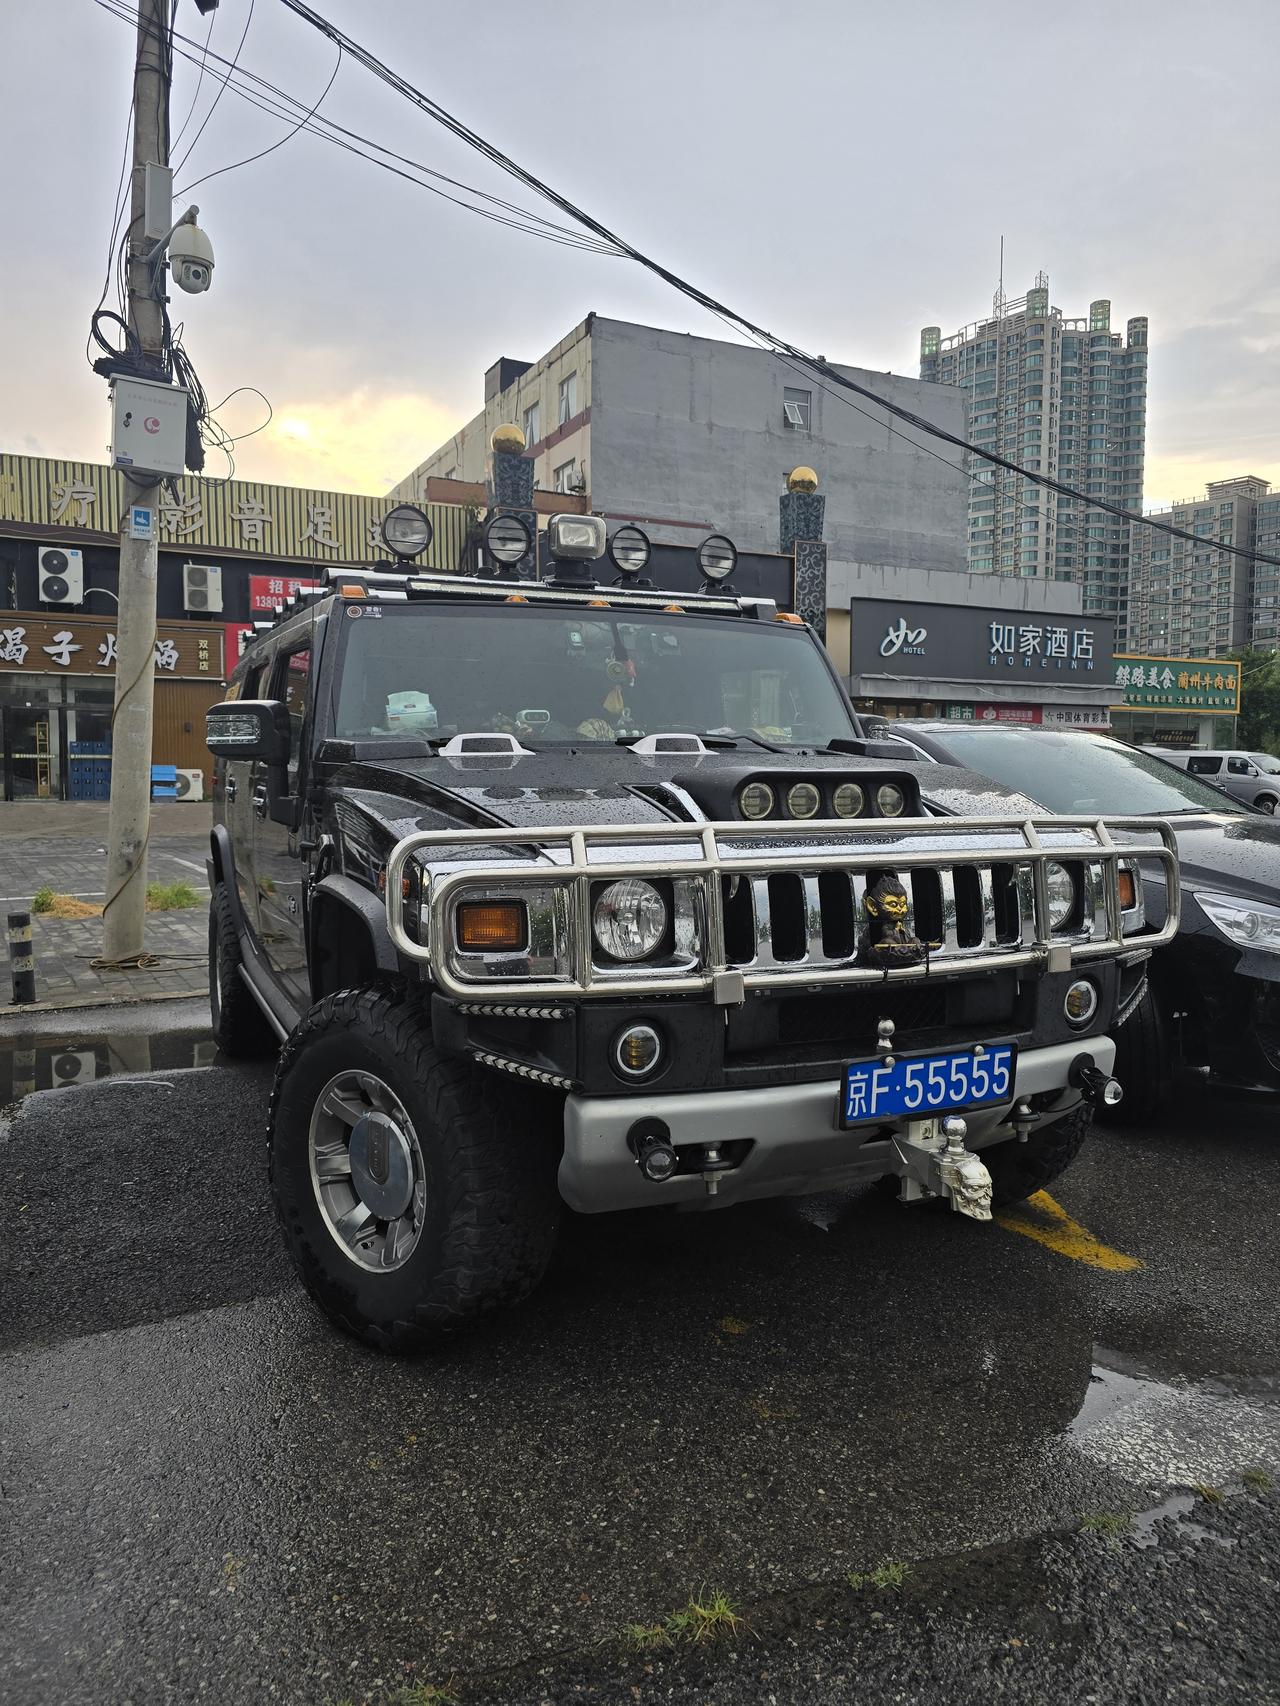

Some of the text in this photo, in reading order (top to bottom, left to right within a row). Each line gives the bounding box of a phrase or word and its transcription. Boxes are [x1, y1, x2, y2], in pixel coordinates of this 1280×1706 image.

[52, 479, 96, 525] 疗
[198, 639, 209, 671] 双桥店
[903, 647, 925, 655] HOTEL
[989, 621, 1094, 659] 如家酒店
[950, 705, 973, 719] 超市
[1056, 711, 1108, 724] 中国体育彩票
[847, 1051, 1011, 1117] 京F·55555
